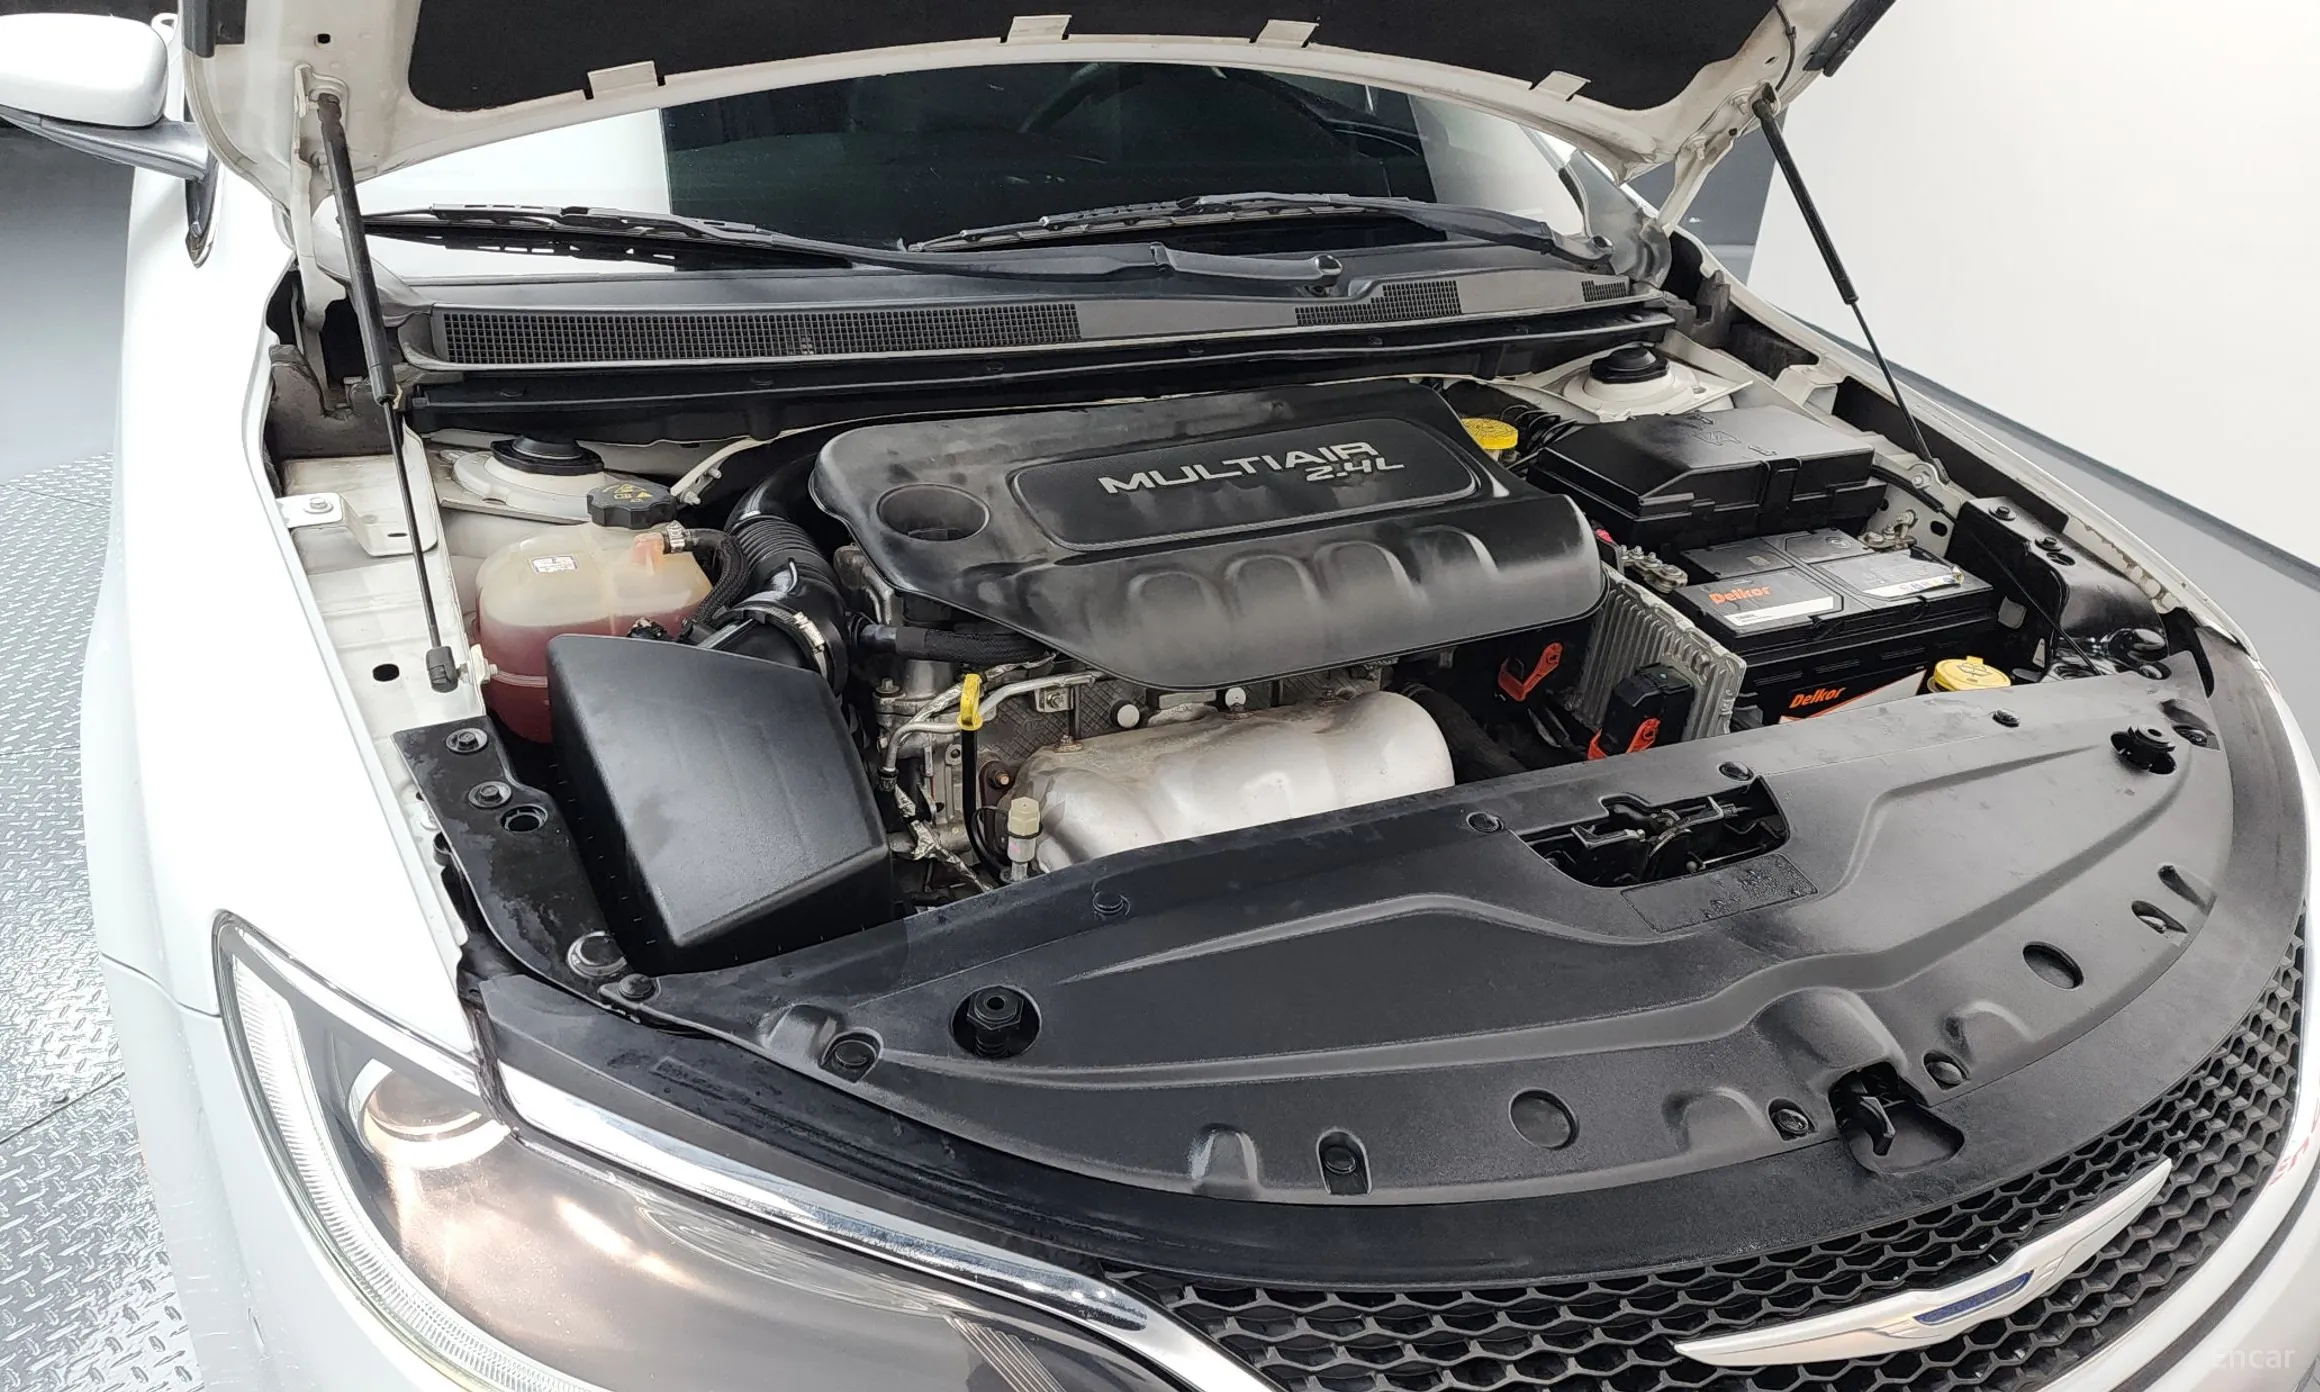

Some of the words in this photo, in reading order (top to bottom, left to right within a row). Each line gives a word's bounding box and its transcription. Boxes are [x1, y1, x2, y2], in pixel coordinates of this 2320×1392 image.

[1099, 442, 1380, 494] MULTIAIR
[1305, 457, 1405, 482] 2.4L
[1709, 586, 1771, 605] Delkor
[1789, 688, 1846, 709] Delkor
